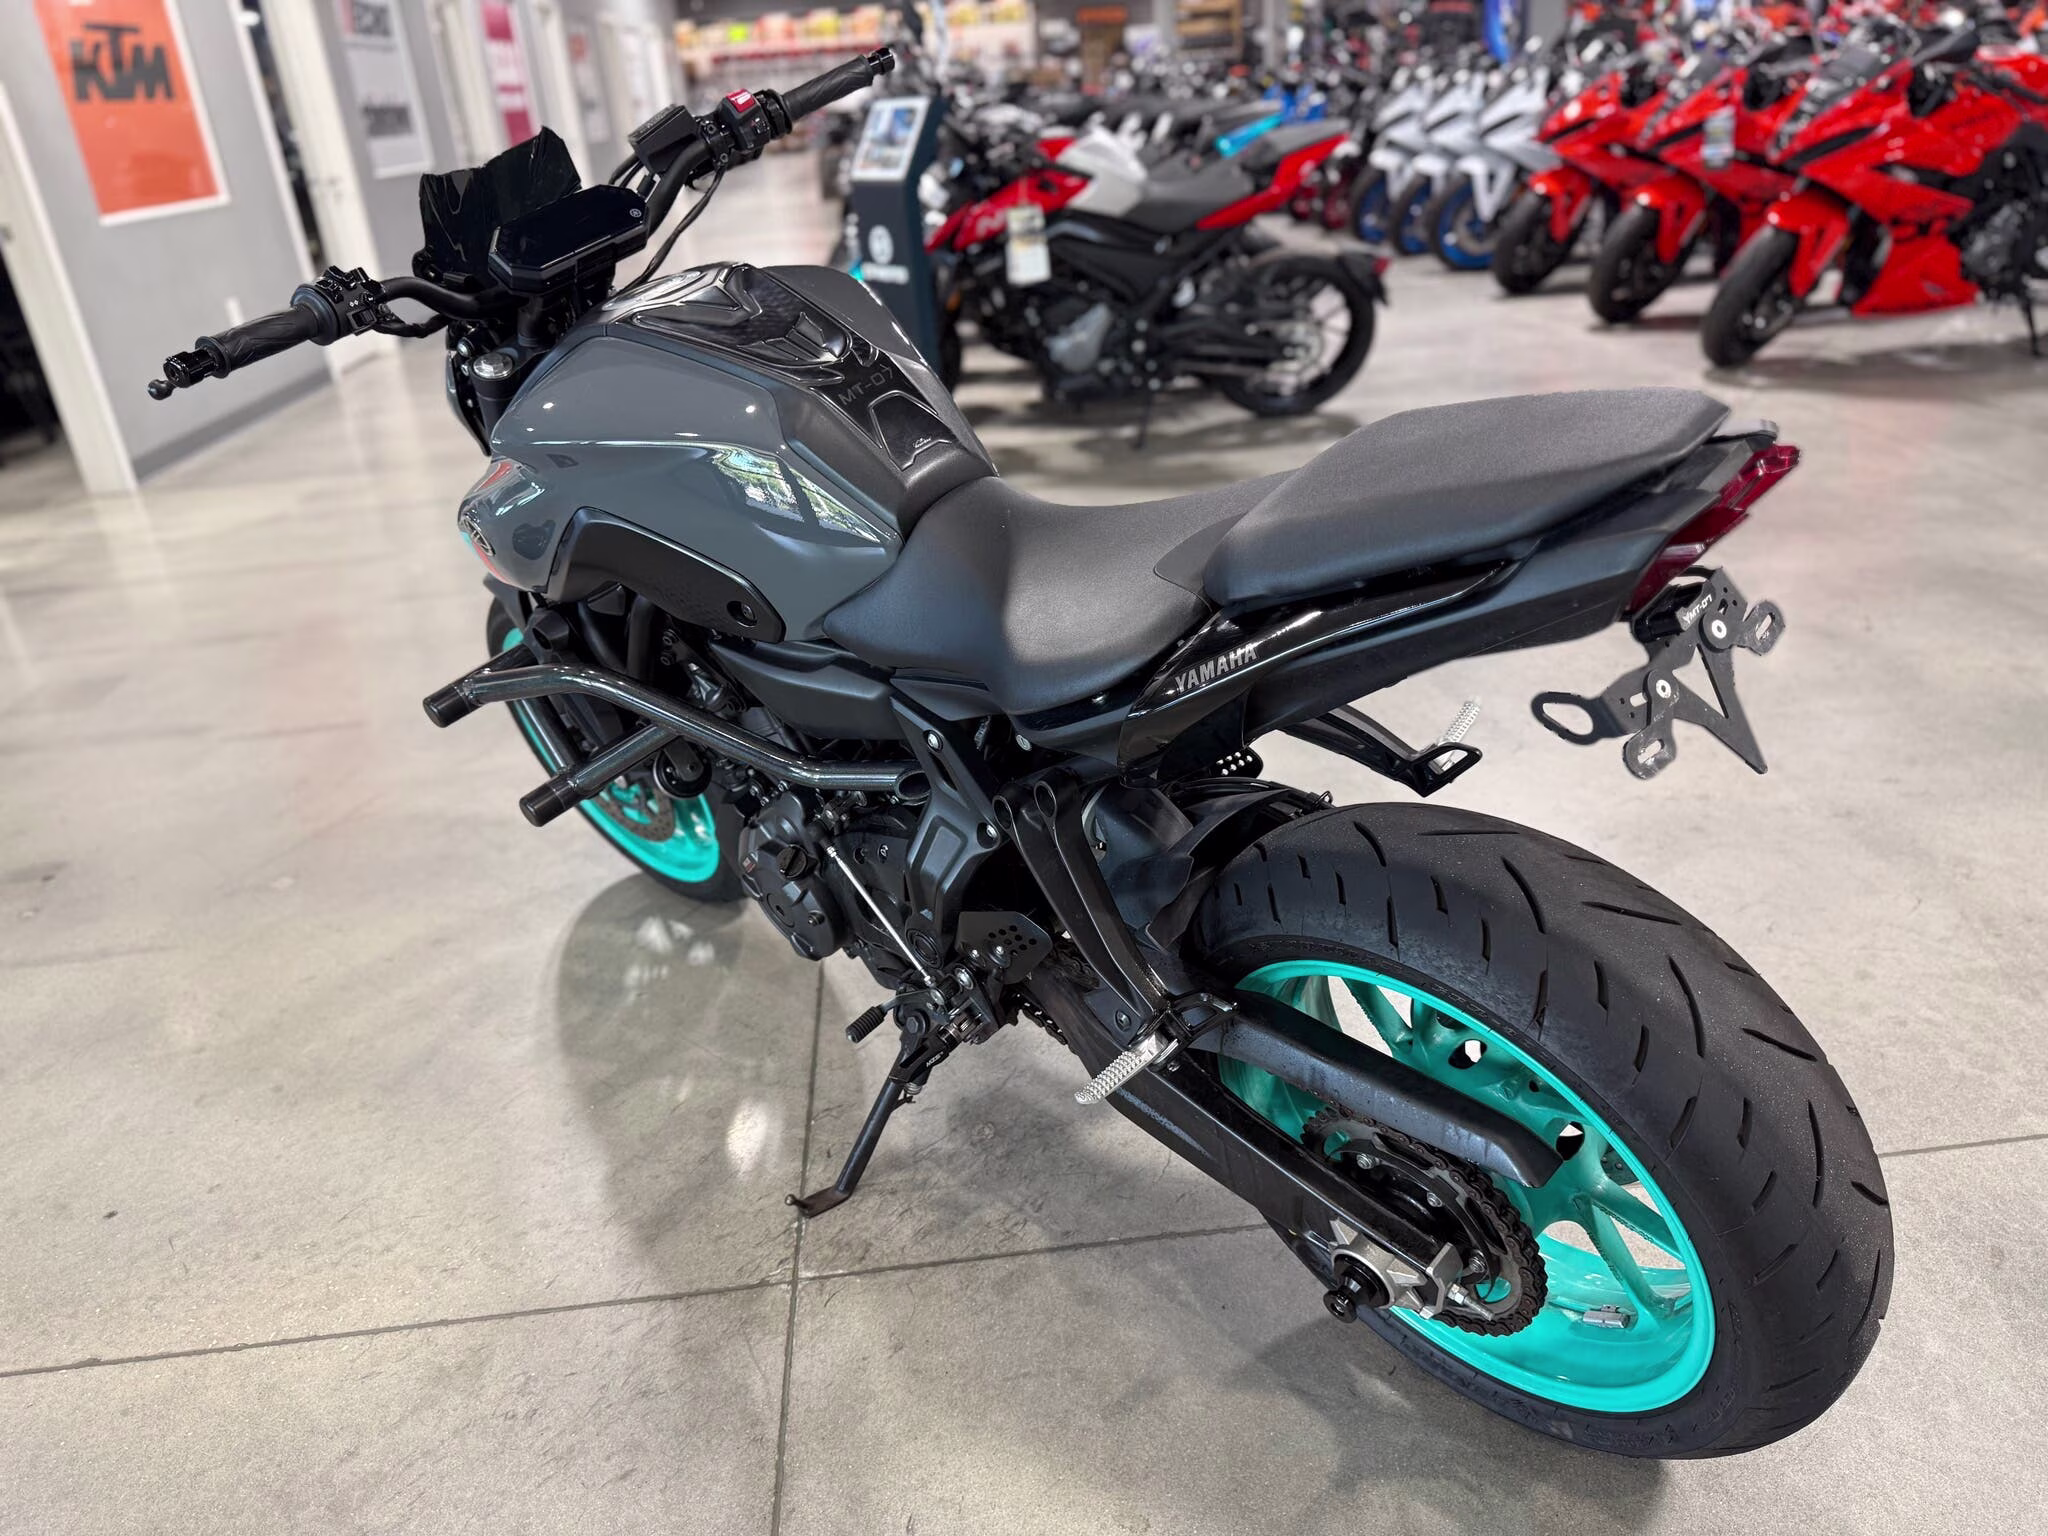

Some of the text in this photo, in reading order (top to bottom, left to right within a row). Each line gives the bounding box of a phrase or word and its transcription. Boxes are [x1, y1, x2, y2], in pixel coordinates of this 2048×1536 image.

[71, 24, 173, 100] KTM
[838, 363, 893, 405] MT-07
[1175, 643, 1257, 693] YAMAHA
